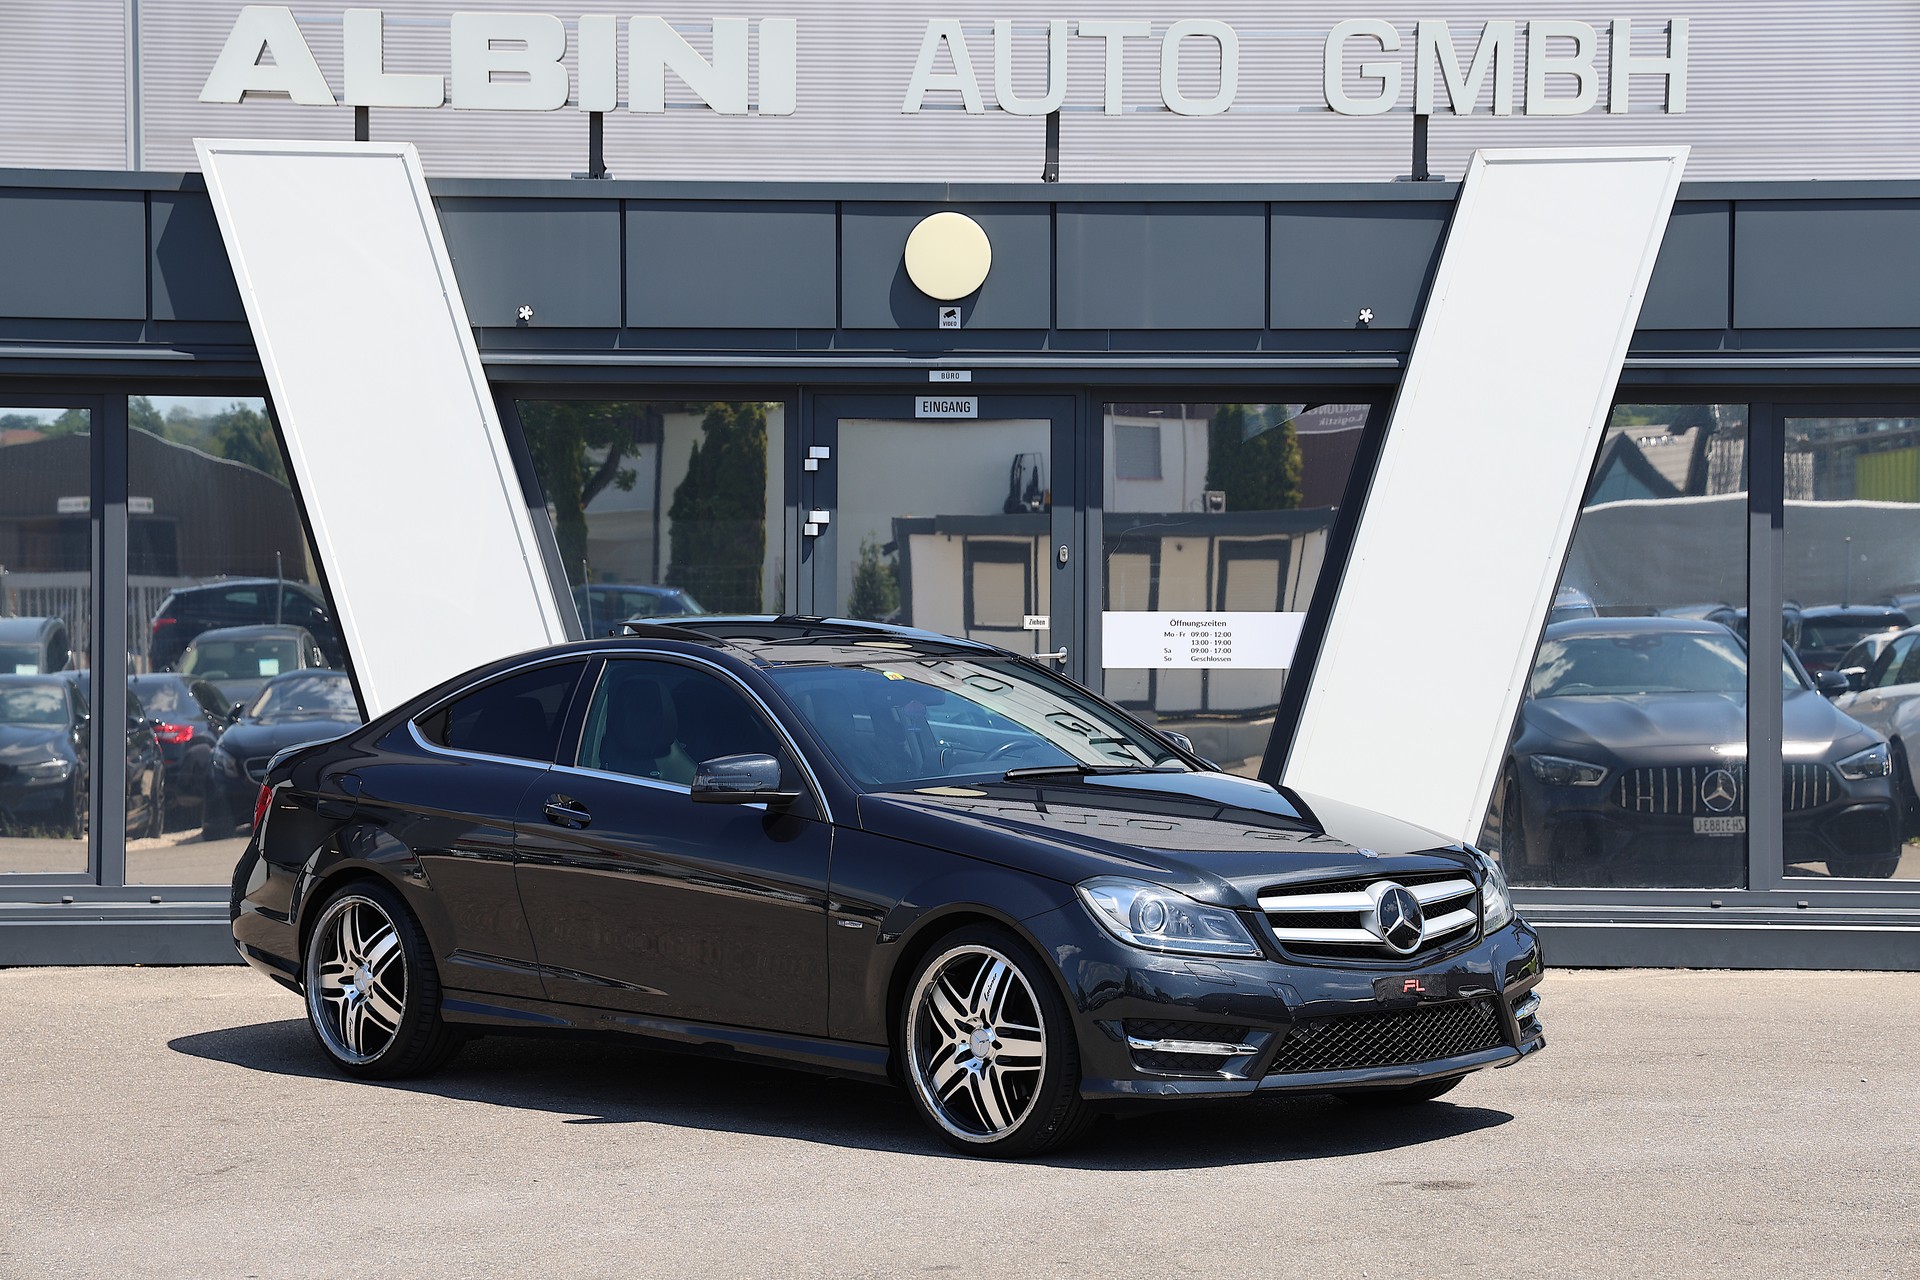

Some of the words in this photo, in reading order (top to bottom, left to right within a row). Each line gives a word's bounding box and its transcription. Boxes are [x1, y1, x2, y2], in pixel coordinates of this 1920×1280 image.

[198, 5, 797, 116] ALBINI
[901, 18, 1239, 116] AUTO
[1322, 18, 1690, 116] GMBH
[940, 372, 960, 380] BÜRO
[922, 401, 971, 413] EINGANG
[1029, 618, 1046, 626] Ziehen
[1169, 618, 1227, 628] Öffnungszeiten
